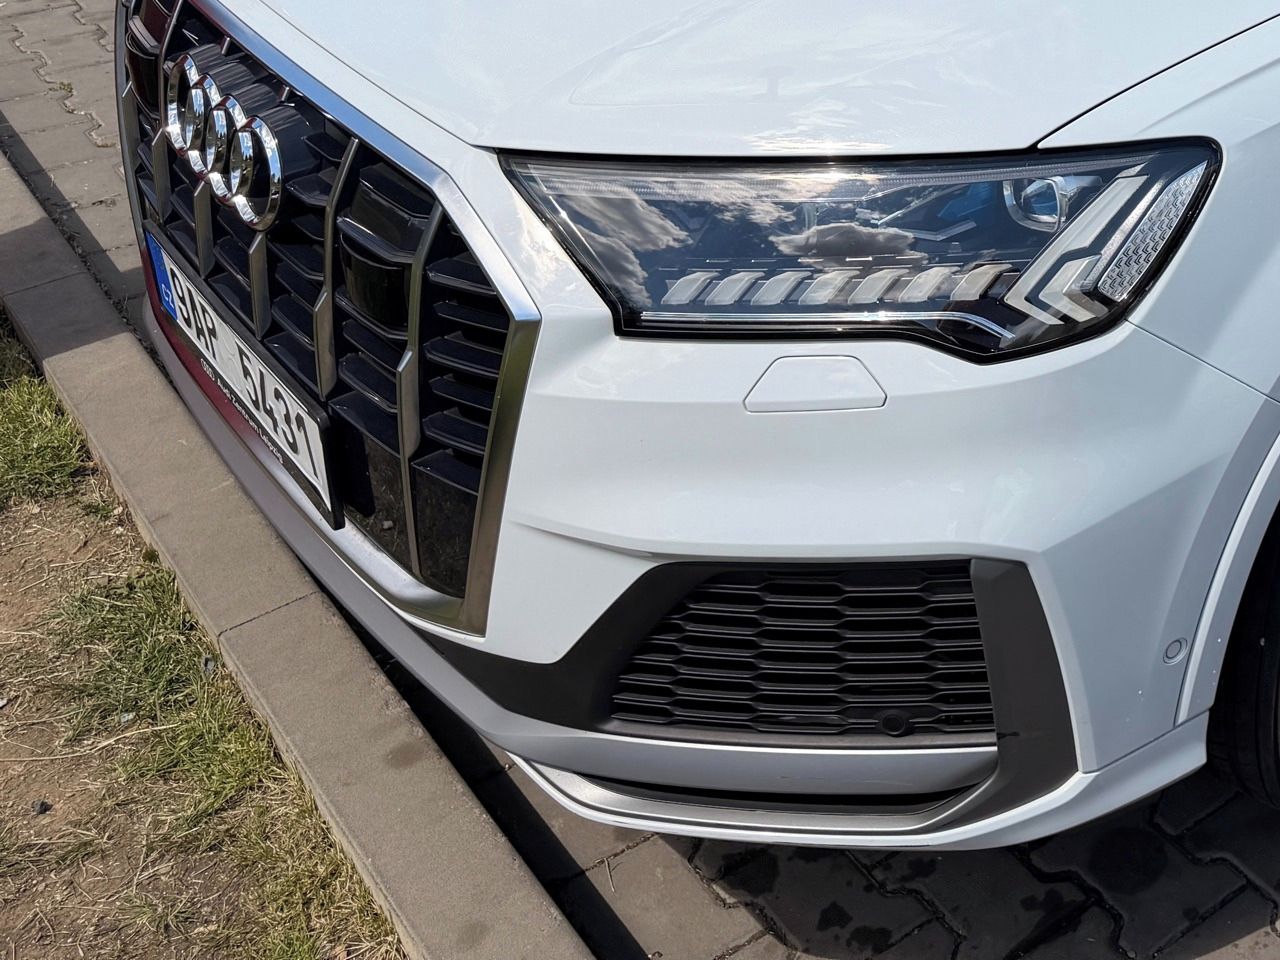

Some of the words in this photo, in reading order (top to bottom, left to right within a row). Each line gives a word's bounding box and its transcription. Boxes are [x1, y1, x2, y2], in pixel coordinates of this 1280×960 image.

[161, 283, 175, 309] CZ
[169, 266, 218, 361] 9AP
[235, 340, 320, 481] 5431
